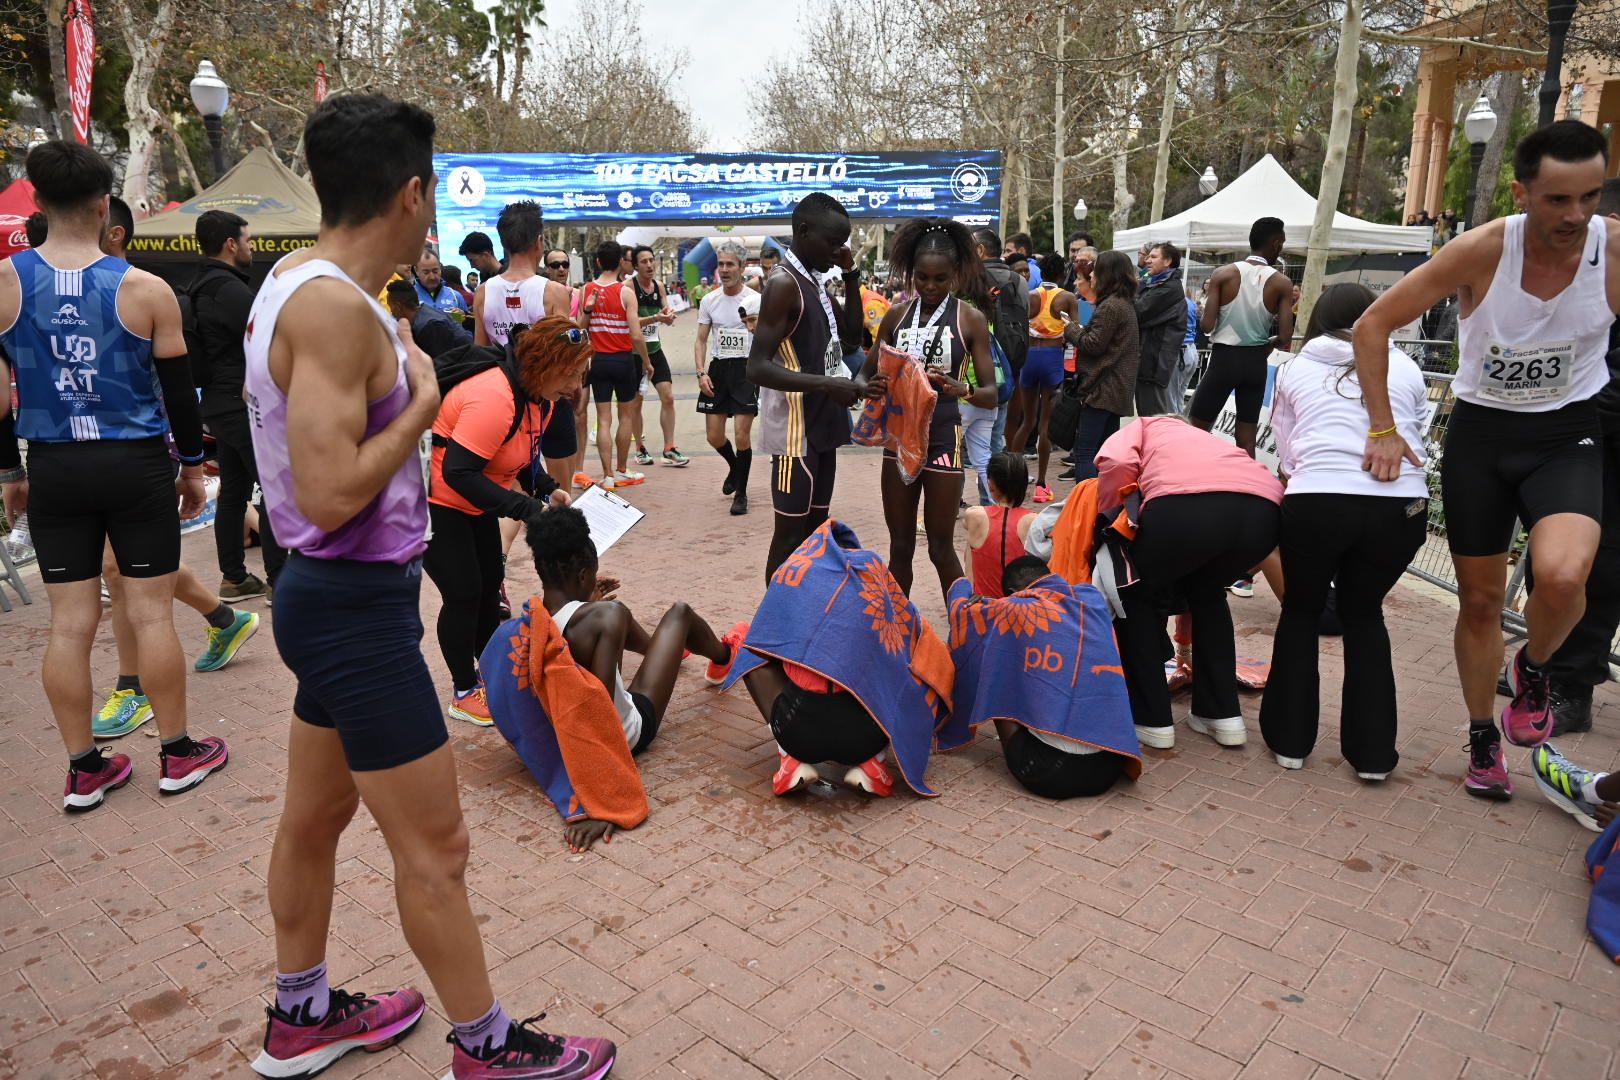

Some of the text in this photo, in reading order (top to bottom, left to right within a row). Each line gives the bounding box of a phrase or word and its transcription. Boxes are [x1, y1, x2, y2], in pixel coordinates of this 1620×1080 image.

[592, 157, 847, 183] 10K FACSA CASTELLÓ
[700, 203, 770, 214] 00:33:57
[642, 325, 656, 334] 238
[720, 336, 744, 346] 2031
[901, 340, 944, 357] 268
[1489, 356, 1561, 381] 2263
